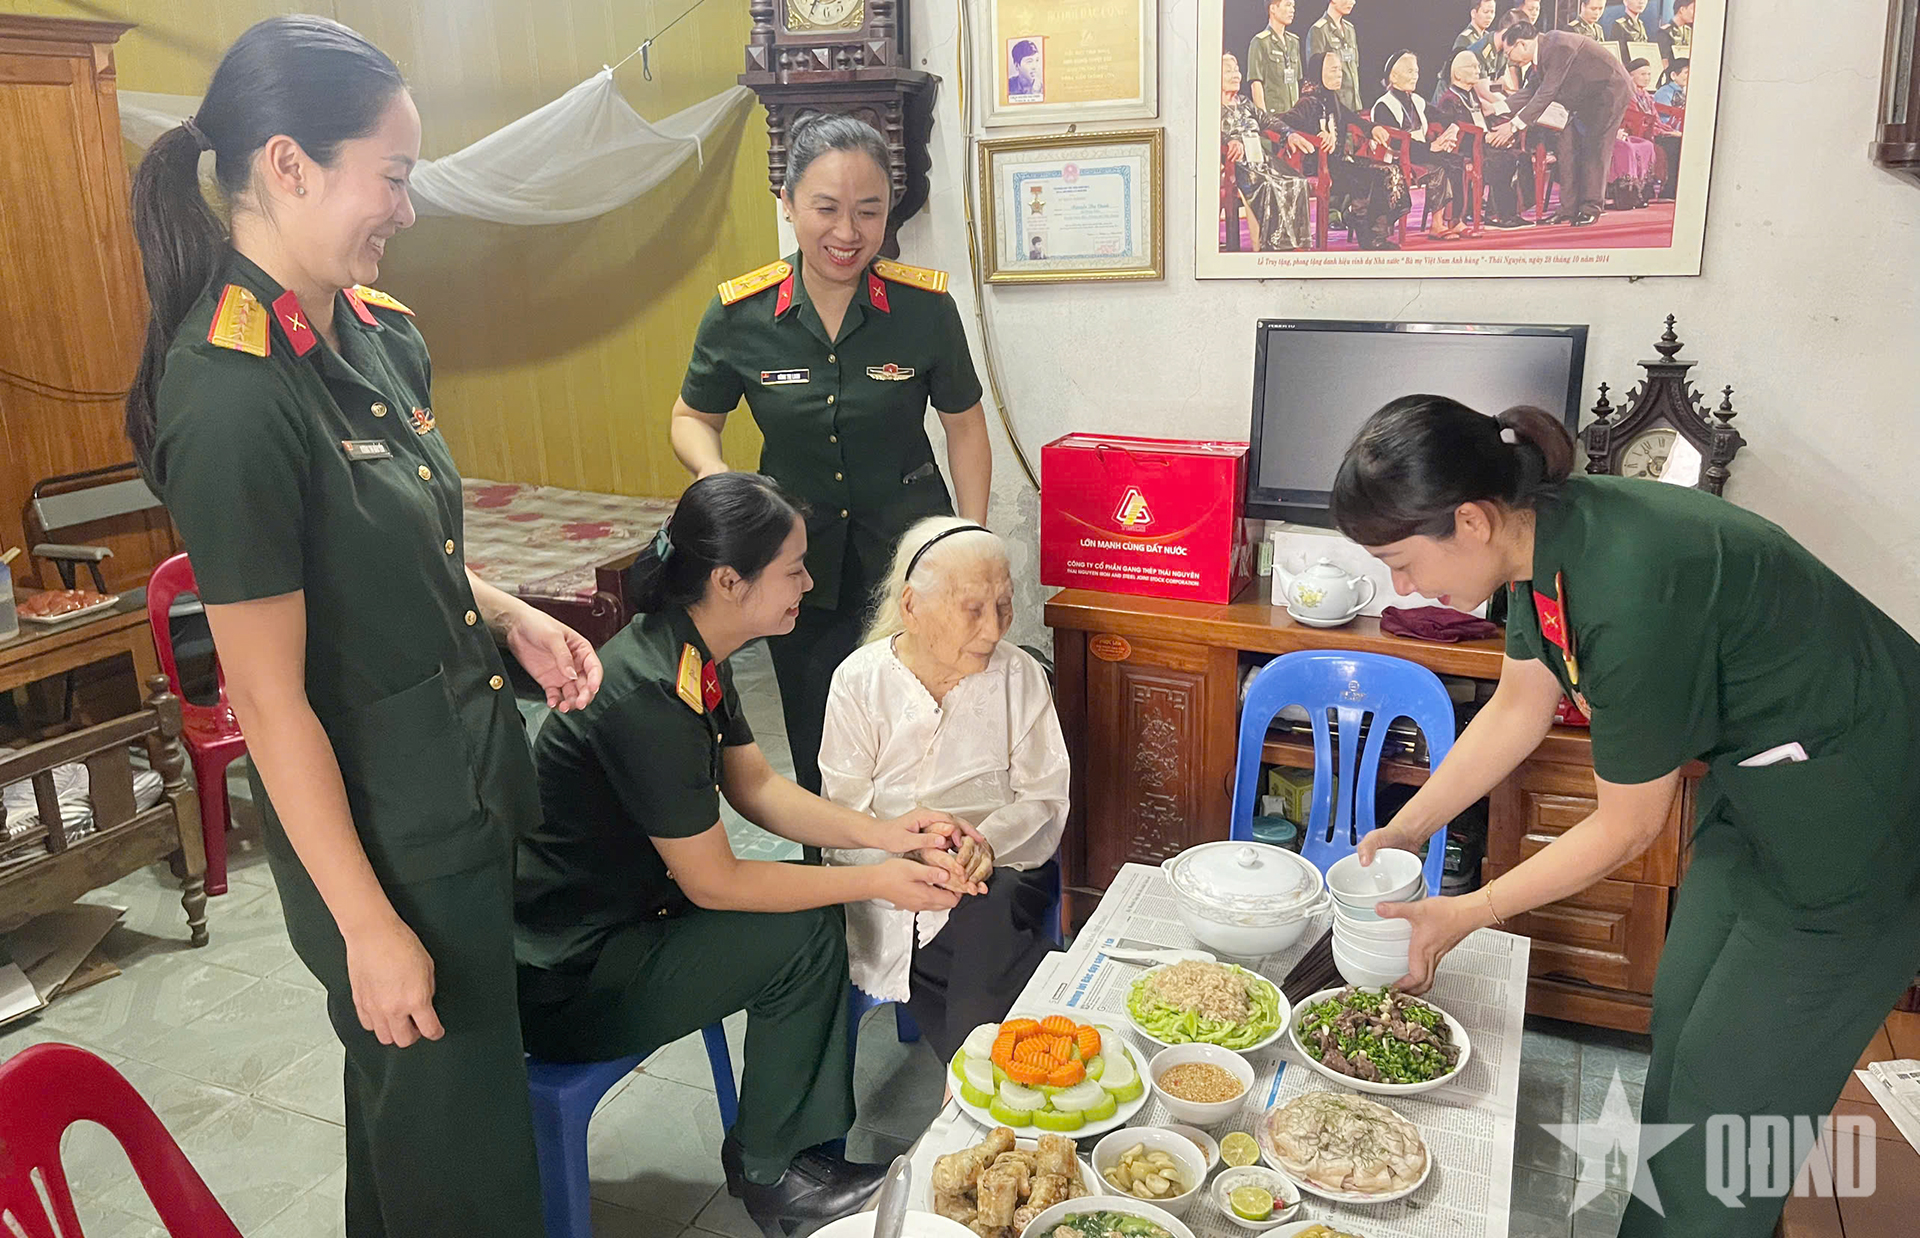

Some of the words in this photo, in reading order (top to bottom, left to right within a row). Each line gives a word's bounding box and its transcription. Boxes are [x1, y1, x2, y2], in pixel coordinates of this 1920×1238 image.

[1265, 257, 1277, 266] Truy
[1293, 258, 1309, 266] phong
[1323, 257, 1338, 265] danh
[1437, 256, 1450, 264] Nam
[1452, 256, 1463, 264] Anh
[1489, 256, 1503, 264] Thái
[1572, 255, 1579, 263] 10
[1595, 255, 1610, 263] 2014
[1080, 538, 1096, 547] LỚN
[1097, 540, 1121, 550] MẠNH
[1122, 541, 1145, 552] CÙNG
[1146, 543, 1162, 553] ĐẤT
[1164, 545, 1188, 556] NƯỚC
[1094, 561, 1104, 569] CỔ
[1105, 563, 1122, 571] PHẦN
[1122, 565, 1142, 573] GANG
[1142, 566, 1158, 575] THÉP
[1158, 568, 1171, 576] THÁI
[1172, 570, 1200, 579] NGUYÊN
[1165, 577, 1200, 586] CORPORATION
